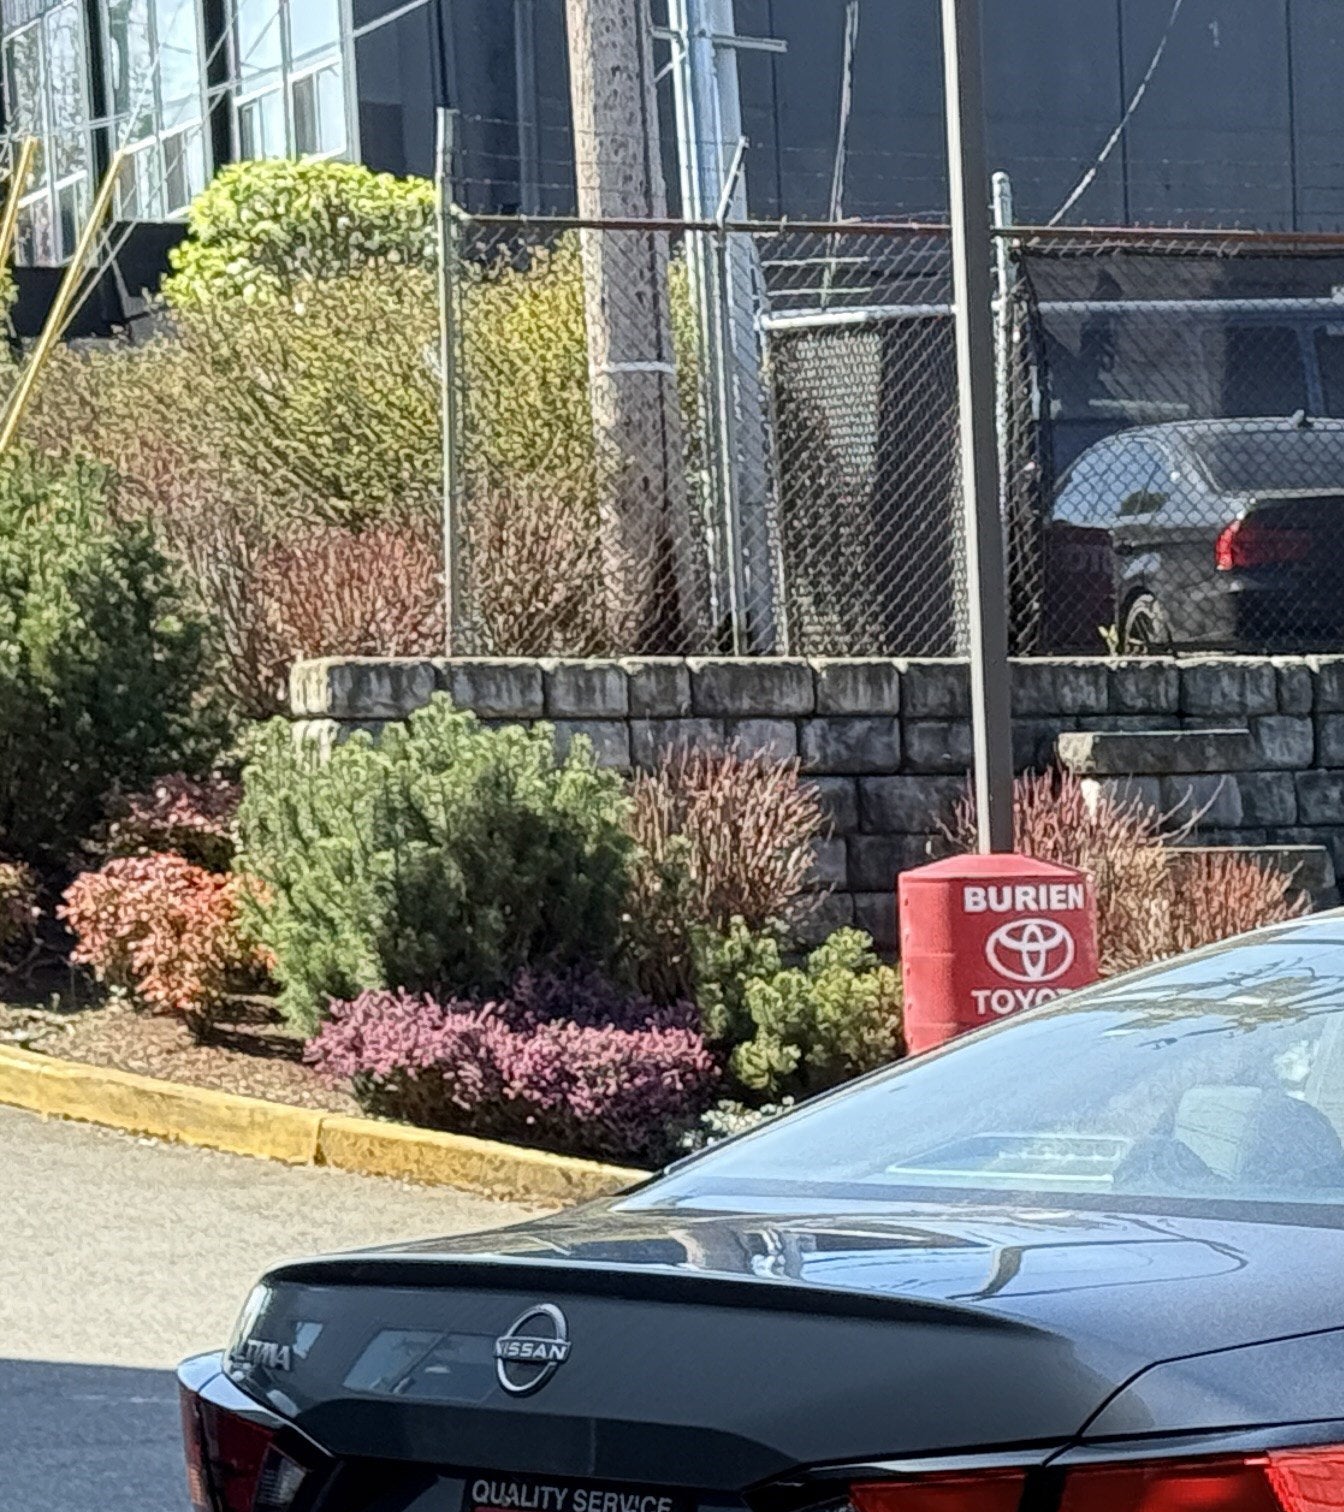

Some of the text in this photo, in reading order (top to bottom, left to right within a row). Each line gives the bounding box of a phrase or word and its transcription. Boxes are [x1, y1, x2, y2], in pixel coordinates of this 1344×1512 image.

[963, 884, 1084, 912] BURIEN
[971, 988, 1072, 1015] TOYO
[499, 1341, 568, 1361] NISSAN
[472, 1480, 569, 1512] QUALITY
